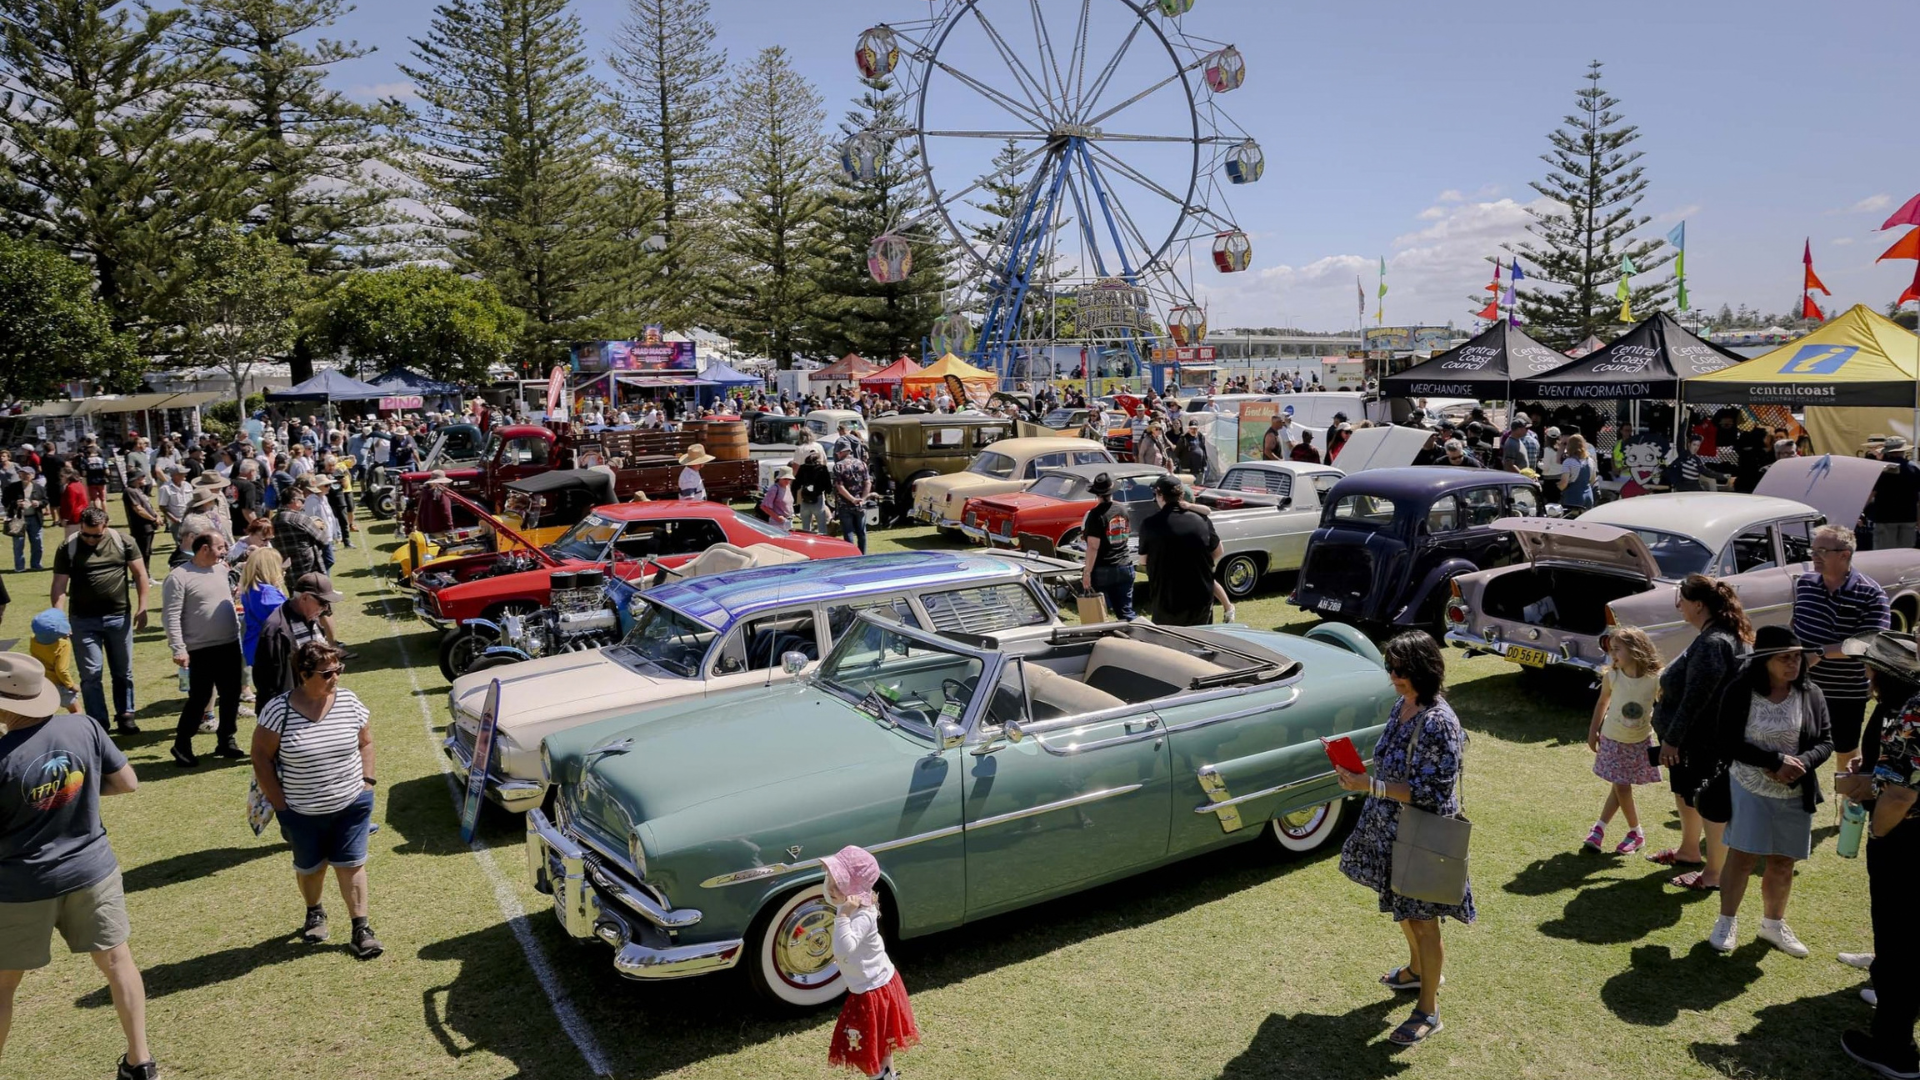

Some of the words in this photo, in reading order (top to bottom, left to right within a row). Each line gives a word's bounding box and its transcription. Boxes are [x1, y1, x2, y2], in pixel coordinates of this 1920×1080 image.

[1459, 346, 1501, 357] Central
[1611, 345, 1661, 357] Central
[1458, 354, 1492, 364] Coast
[1612, 354, 1652, 365] Coast
[1441, 361, 1485, 370] Council
[1592, 363, 1645, 373] Council
[1410, 383, 1473, 396] MERCHANDISE
[1538, 385, 1570, 397] EVENT
[1573, 384, 1650, 398] INFORMATION
[1749, 383, 1836, 396] centralcoast
[1244, 407, 1261, 417] Event
[1520, 649, 1532, 661] 56
[1532, 651, 1546, 664] FA
[30, 780, 60, 800] 1770
